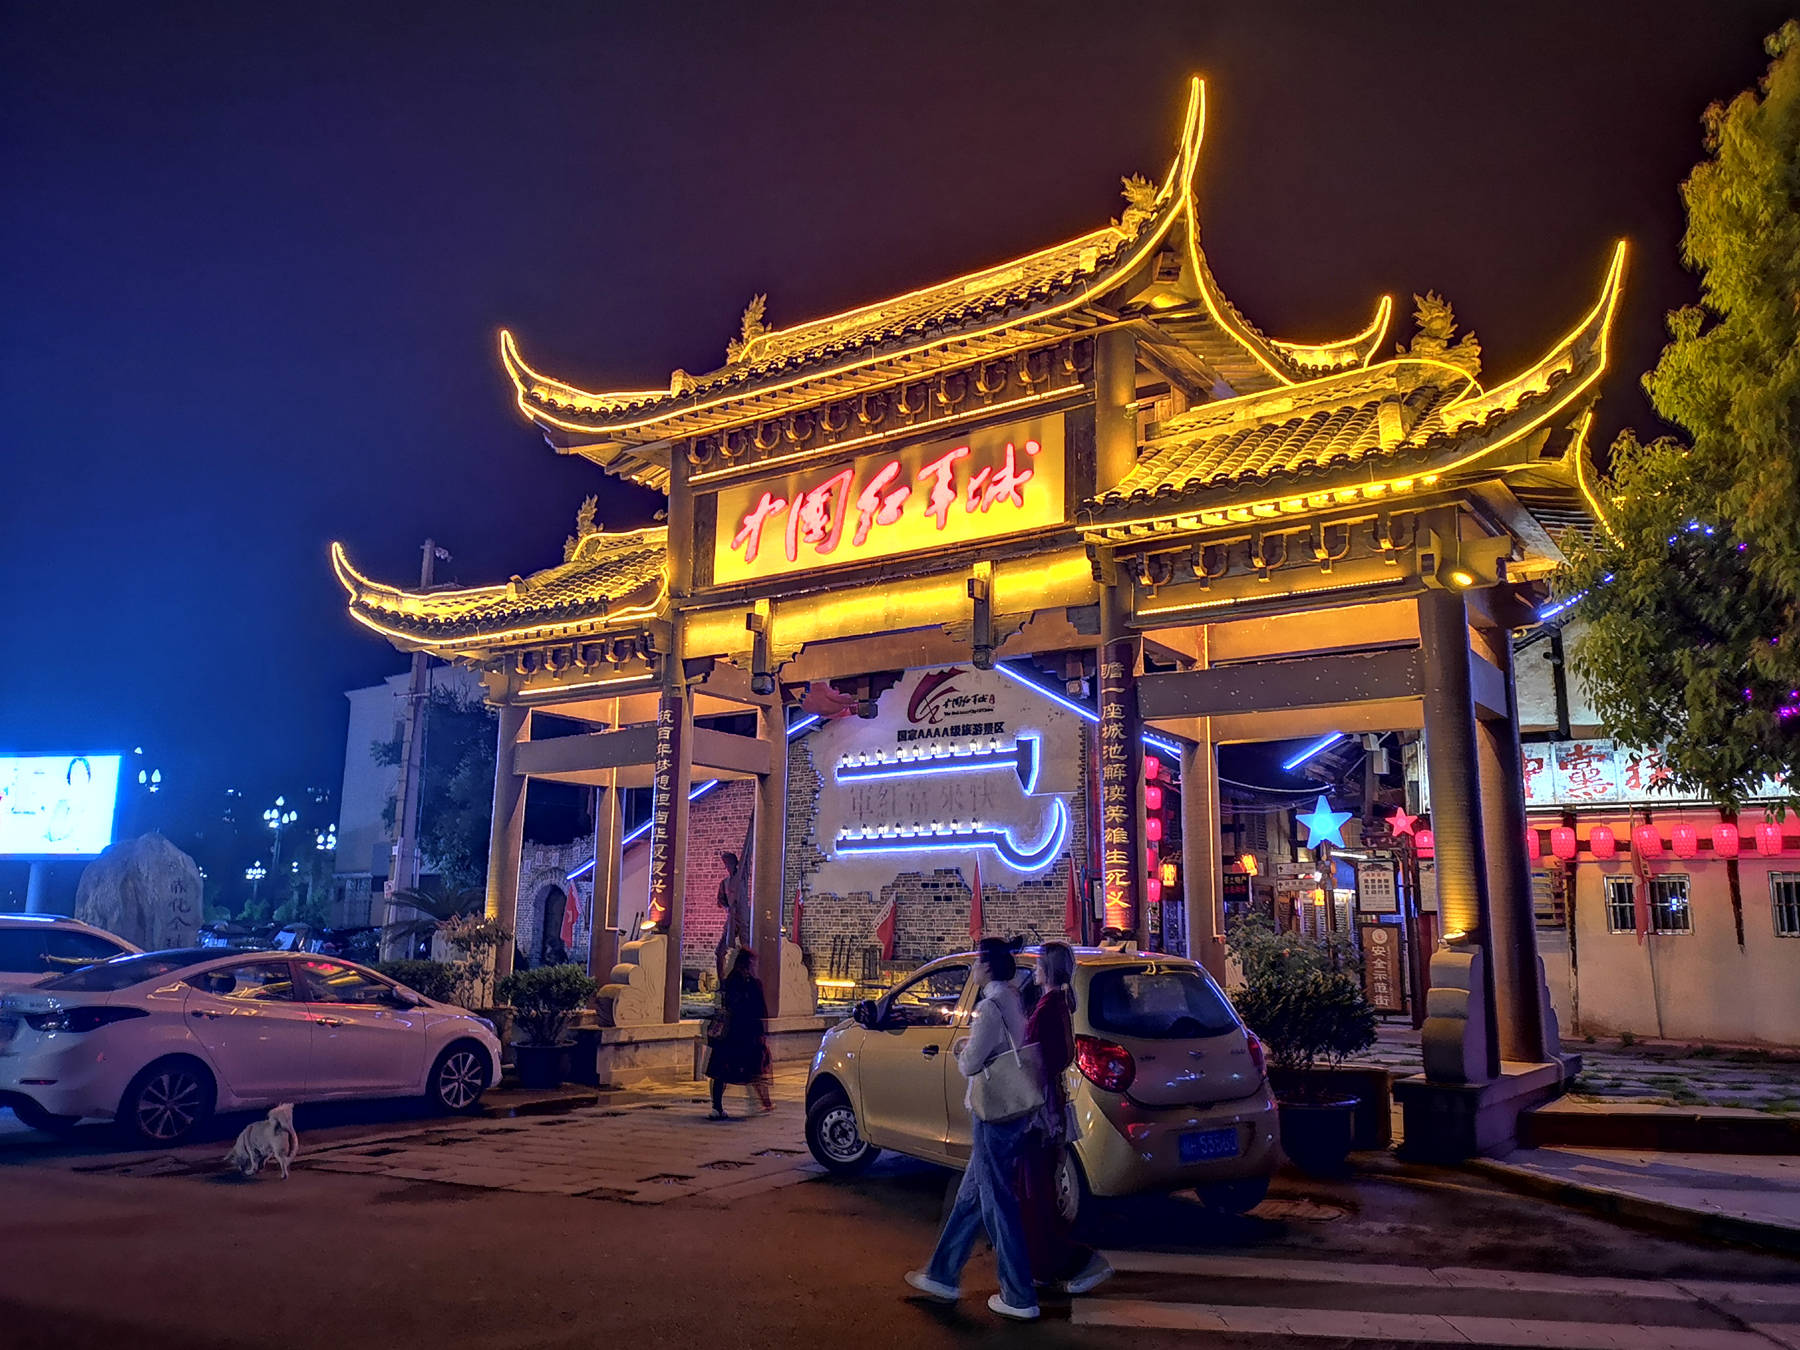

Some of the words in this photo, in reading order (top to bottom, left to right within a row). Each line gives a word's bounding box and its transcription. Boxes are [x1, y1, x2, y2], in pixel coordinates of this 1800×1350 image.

[731, 440, 1041, 563] 中国红军城
[897, 721, 1005, 742] 国家AAAA级旅游景区
[1100, 662, 1131, 908] 瞻一座城池解读英雄生死义
